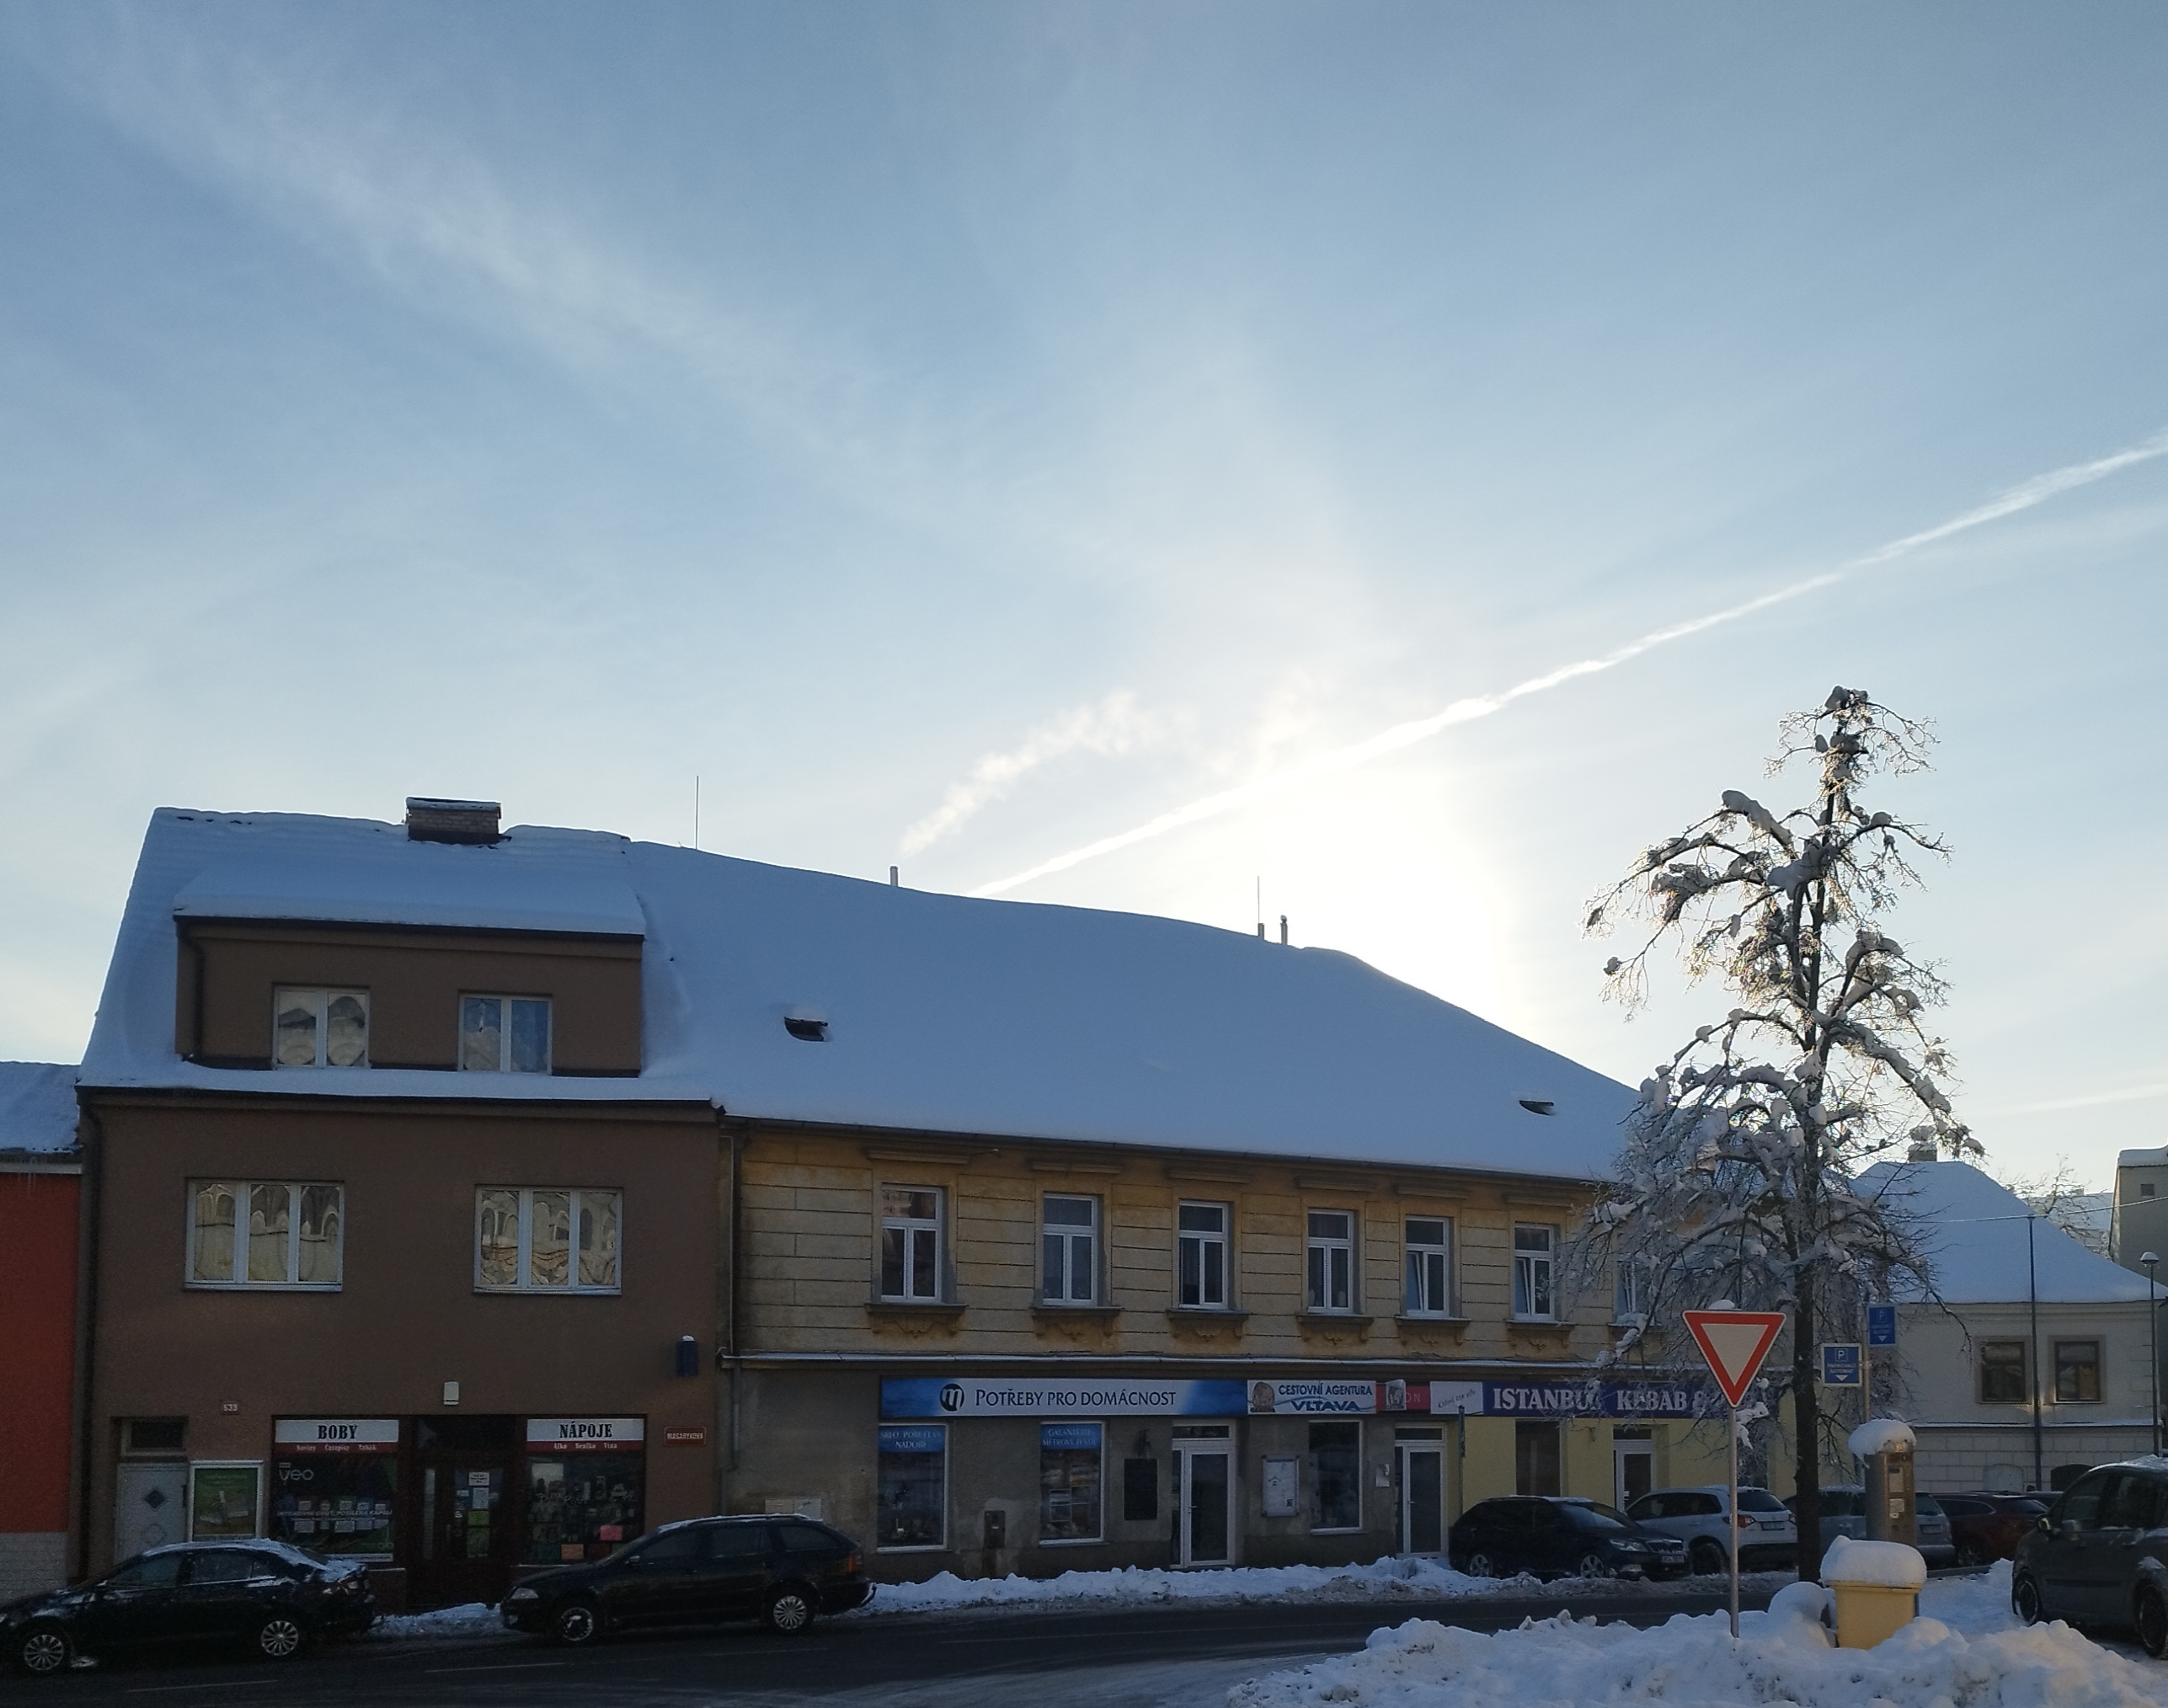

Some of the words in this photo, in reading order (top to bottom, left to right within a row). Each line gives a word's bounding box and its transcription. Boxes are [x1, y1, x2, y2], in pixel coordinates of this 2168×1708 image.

[975, 1388, 1043, 1406] POTŘEBY
[1047, 1391, 1077, 1406] PRO
[1081, 1389, 1177, 1406] DOMÁCNOST
[1278, 1383, 1323, 1396] CESTOVNÍ
[1325, 1385, 1373, 1396] AGENTURA
[1290, 1401, 1360, 1412] VLTAVA
[1616, 1390, 1687, 1411] KEBAB
[318, 1424, 358, 1439] BOBY
[559, 1421, 612, 1438] NÁPOJE
